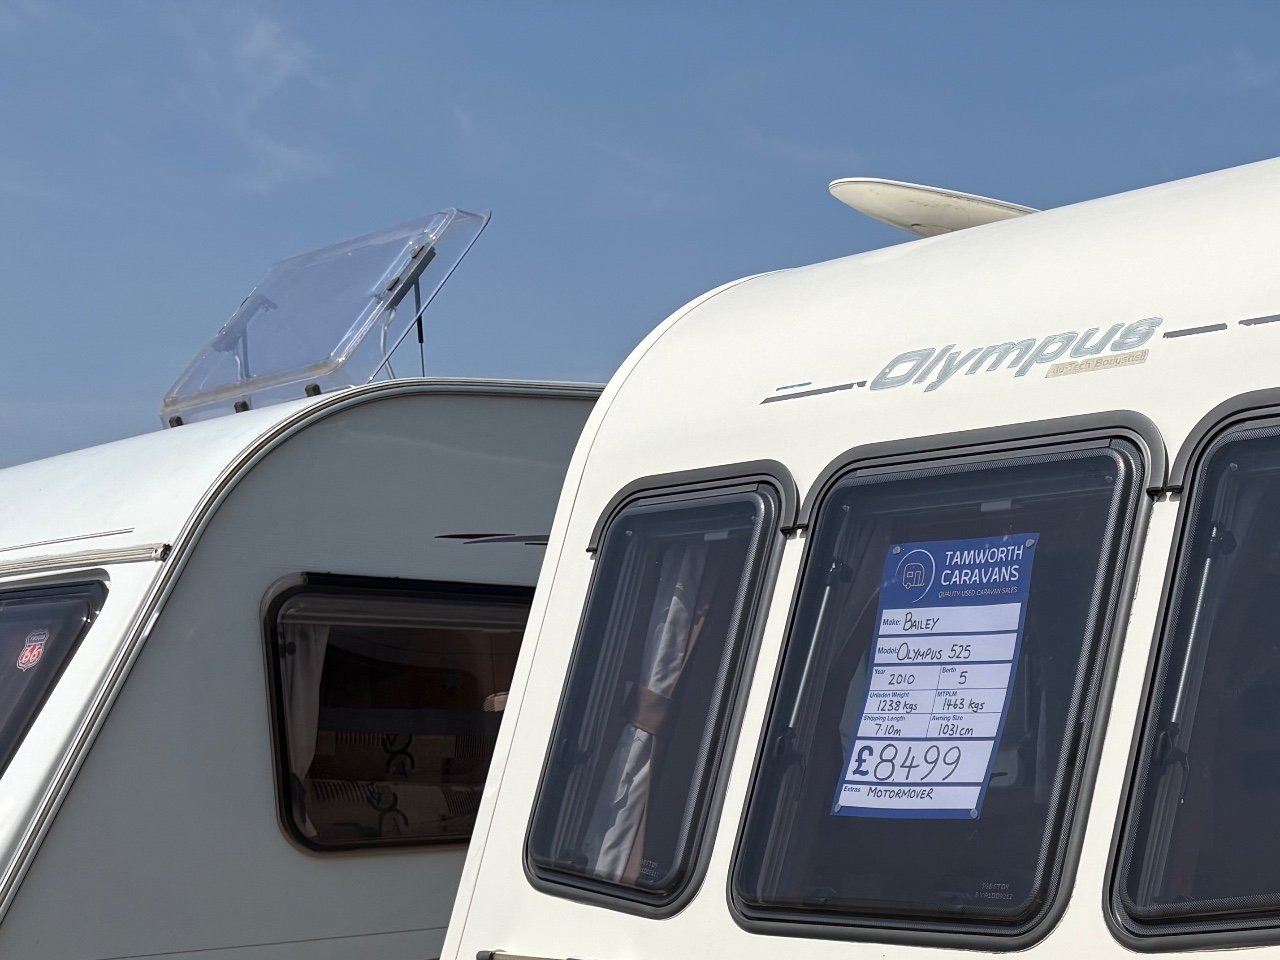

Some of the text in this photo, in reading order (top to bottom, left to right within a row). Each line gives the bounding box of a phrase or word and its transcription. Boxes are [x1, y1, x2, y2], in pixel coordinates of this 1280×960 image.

[869, 317, 1163, 392] Olympus
[945, 544, 1024, 566] TAMWORTH
[940, 565, 1020, 586] CARAVANS
[938, 586, 1018, 599] QUALITY USED CARAVAN SALES
[948, 644, 972, 660] 525
[941, 666, 957, 674] Berth
[887, 673, 916, 686] 2010
[958, 670, 968, 685] 5
[891, 691, 910, 699] Weight
[877, 699, 901, 712] 1238
[942, 697, 965, 711] 1463
[863, 714, 906, 723] Shipping Length
[931, 714, 951, 722] Awning
[843, 785, 861, 793] Extras
